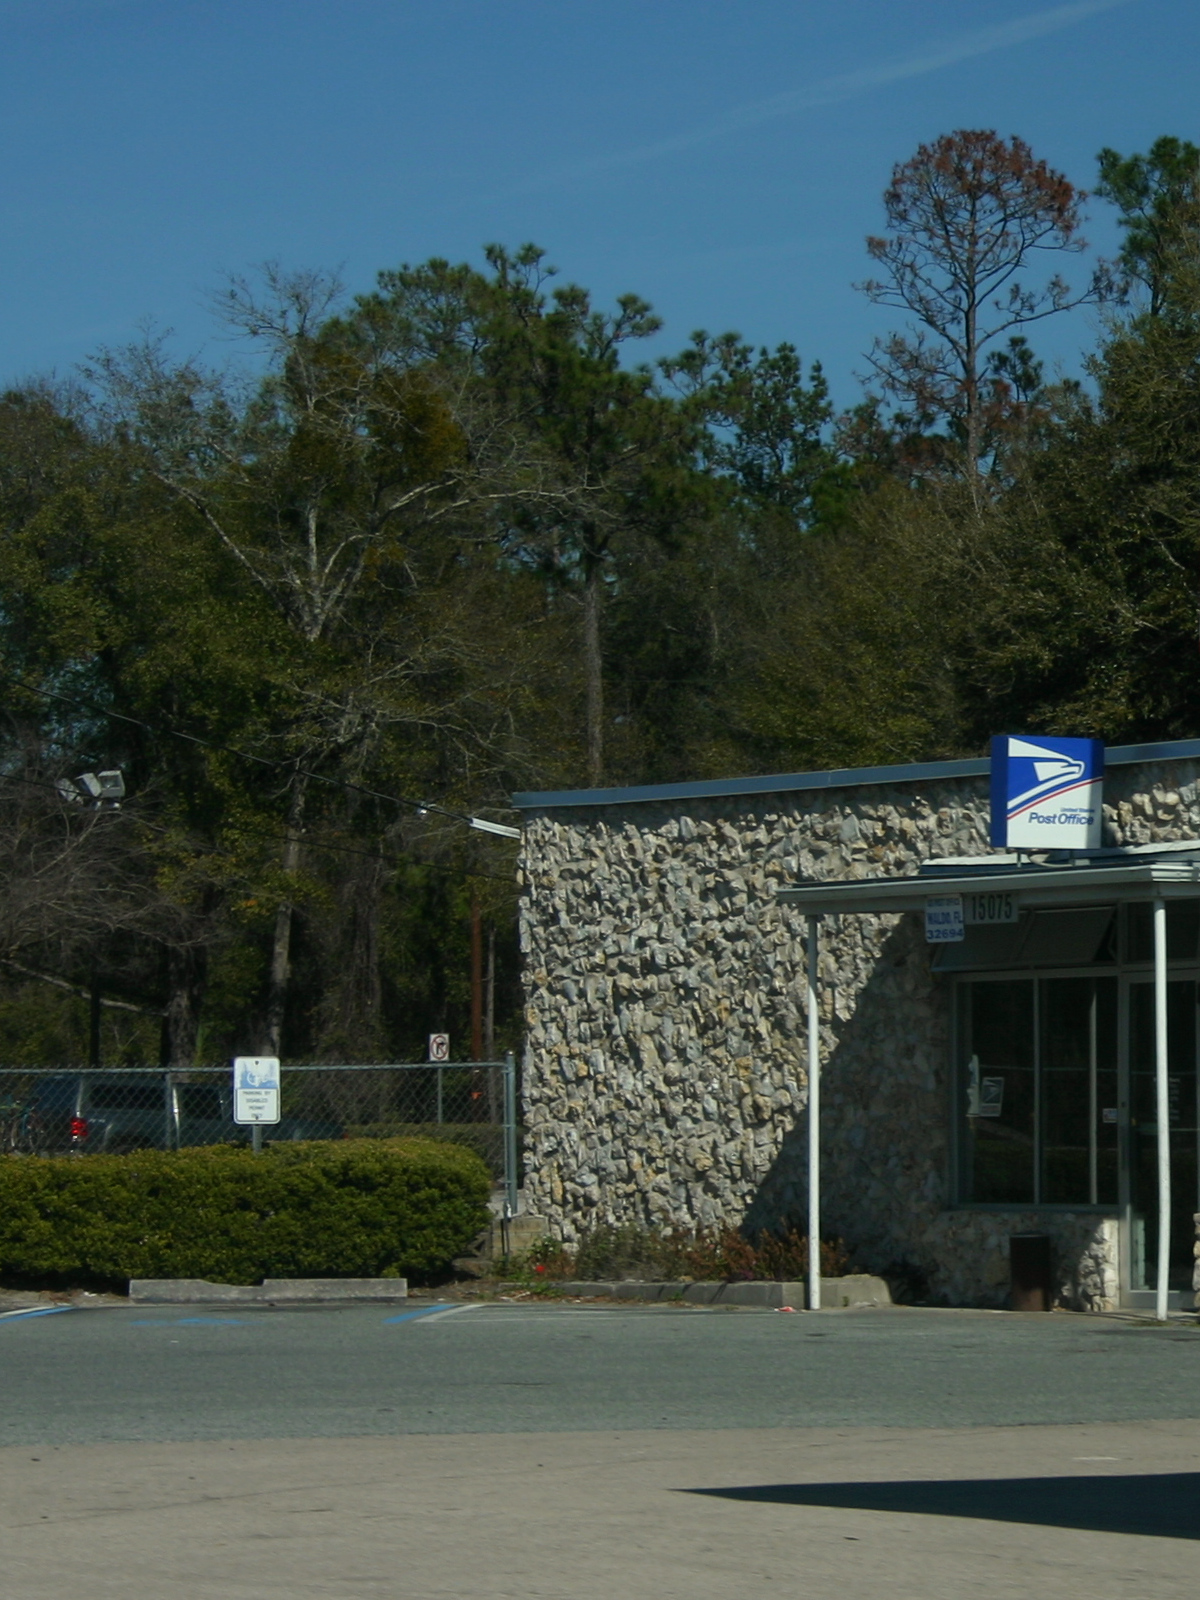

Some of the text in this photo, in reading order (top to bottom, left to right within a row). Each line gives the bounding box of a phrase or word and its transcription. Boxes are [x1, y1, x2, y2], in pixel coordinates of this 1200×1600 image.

[1028, 812, 1094, 826] Post Office
[972, 893, 1012, 921] 15075
[927, 928, 964, 940] 32694
